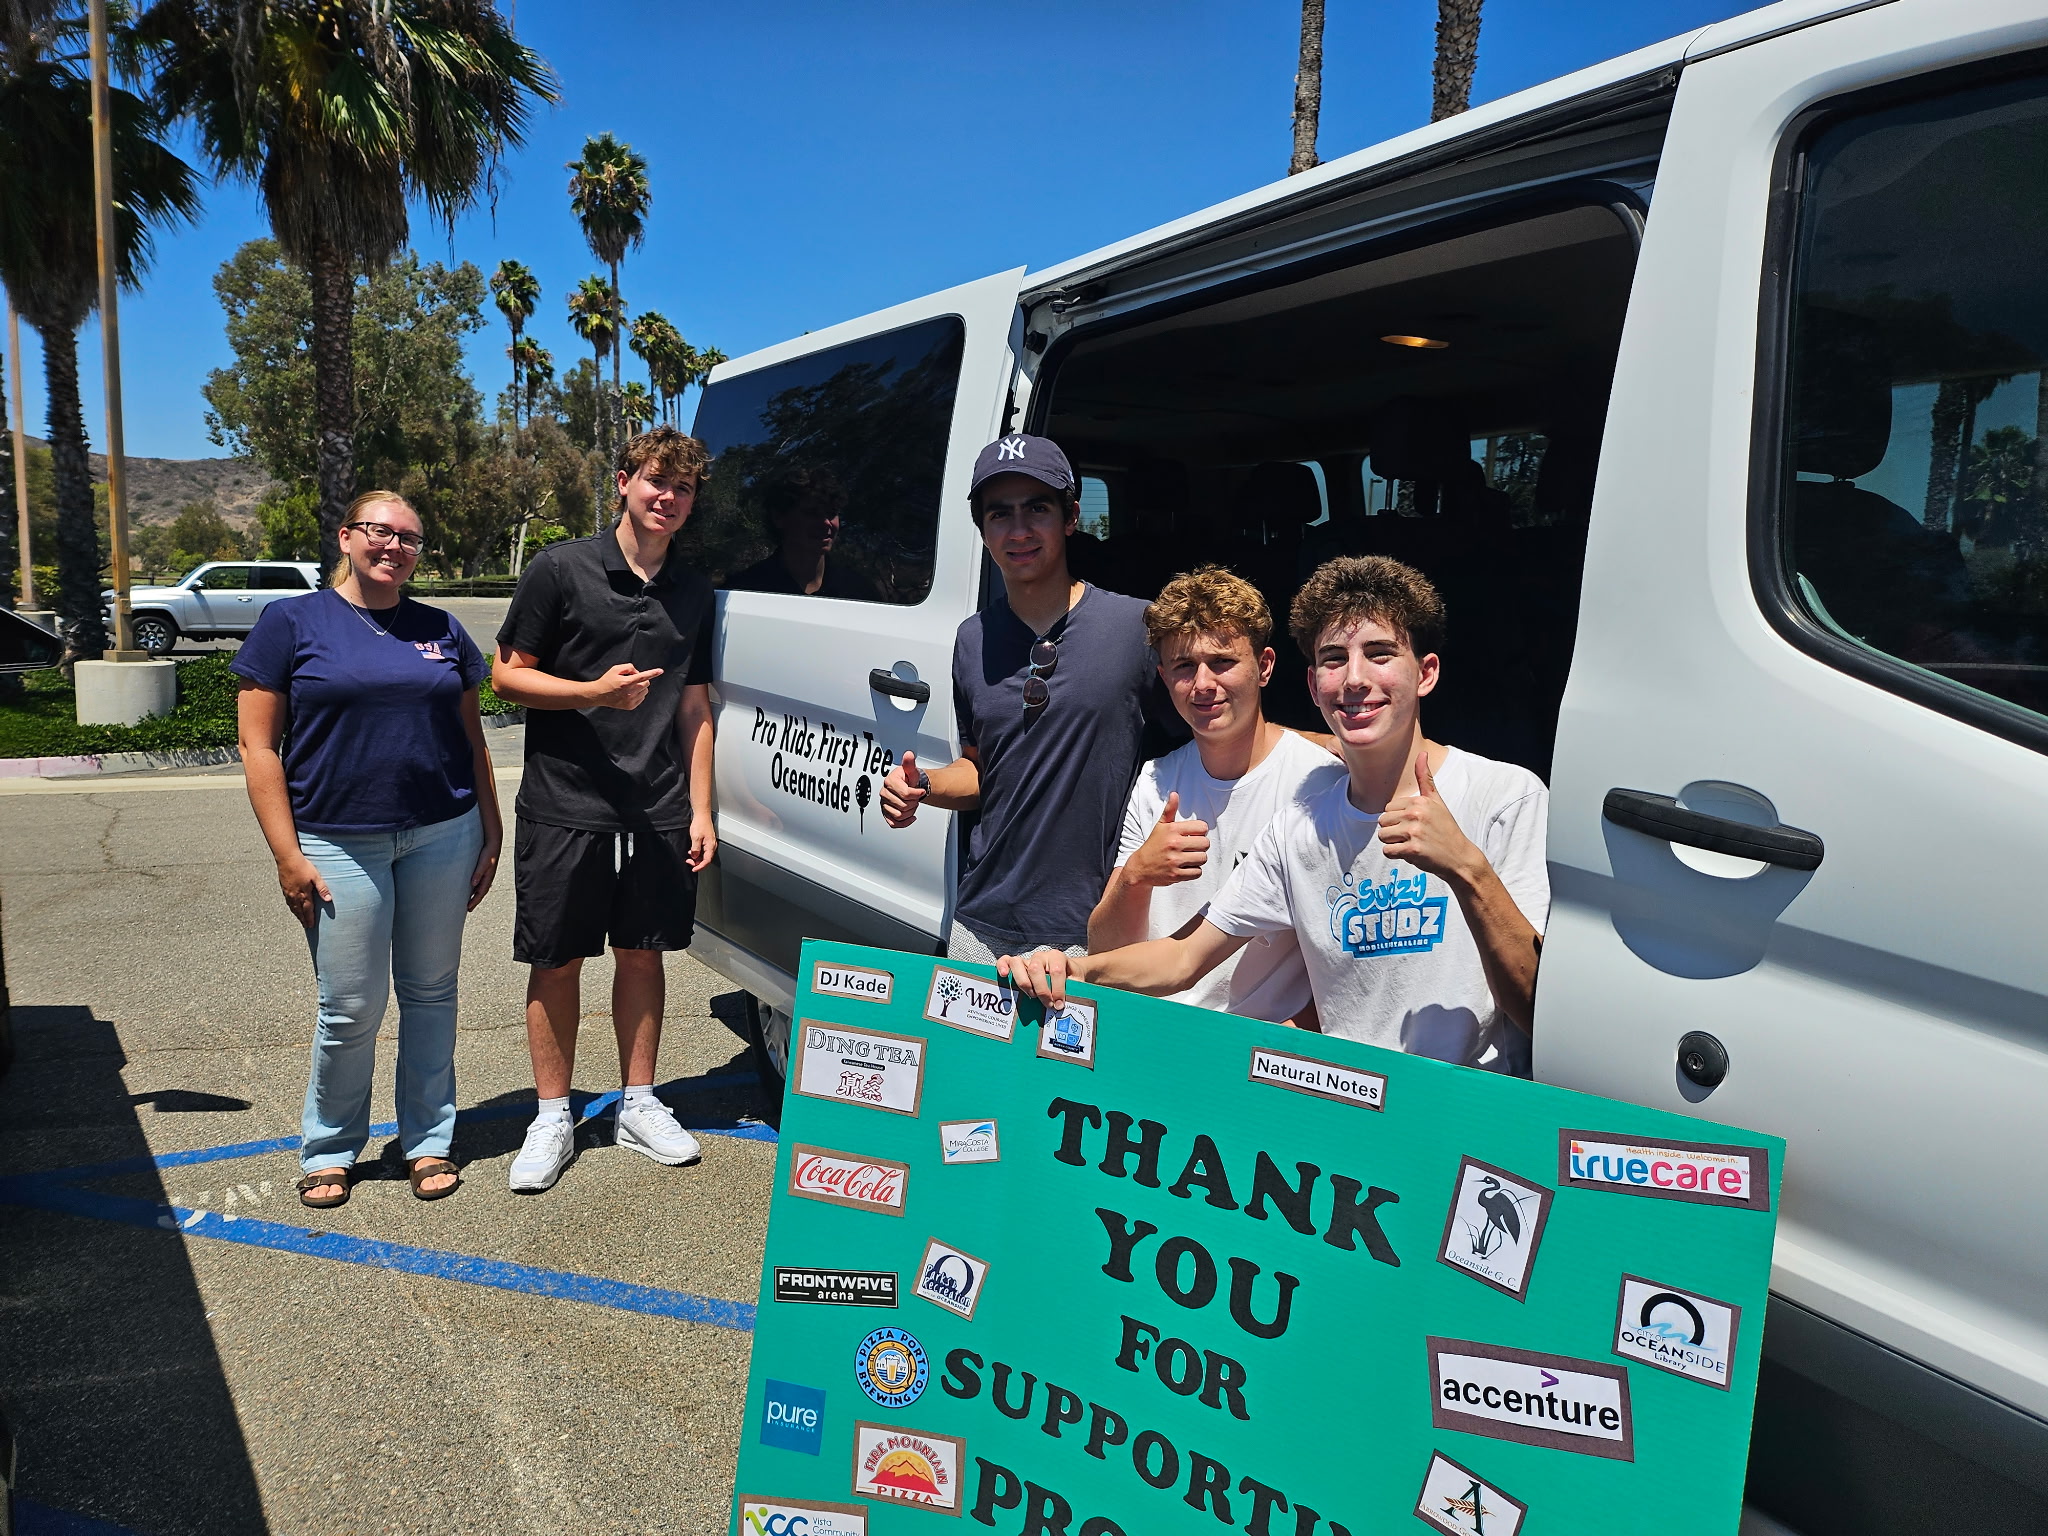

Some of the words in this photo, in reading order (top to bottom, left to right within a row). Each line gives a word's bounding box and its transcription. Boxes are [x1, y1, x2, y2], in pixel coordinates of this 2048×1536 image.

[414, 641, 442, 655] USA
[751, 706, 777, 747] Pro
[817, 721, 859, 769] First
[862, 730, 894, 778] Tee
[771, 752, 851, 814] Oceanside
[1347, 906, 1442, 944] STUDZ
[820, 970, 840, 987] DJ
[844, 974, 887, 994] Kade
[965, 987, 1013, 1016] WRC
[807, 1027, 871, 1058] DING
[873, 1043, 919, 1067] TEA
[1256, 1057, 1321, 1086] Natural
[1326, 1073, 1379, 1100] Notes
[1571, 1145, 1743, 1195] truecare
[1625, 1147, 1655, 1156] Health
[1656, 1148, 1684, 1159] inside.
[1686, 1153, 1726, 1164] Welcome
[1047, 1096, 1401, 1268] THANK
[779, 1272, 893, 1292] FRONTWAVE
[1094, 1206, 1301, 1339] YOU
[1448, 1249, 1493, 1277] Oceanside
[1494, 1271, 1504, 1282] G.
[1507, 1277, 1516, 1288] C.
[817, 1290, 854, 1301] arena
[922, 1276, 972, 1307] Recreation
[859, 1329, 895, 1358] PIZZA
[900, 1332, 926, 1365] PORT
[1621, 1331, 1726, 1374] OCEANSIDE
[1636, 1328, 1654, 1339] CITY
[1654, 1334, 1667, 1342] OF
[1114, 1314, 1251, 1421] FOR
[1654, 1352, 1687, 1371] Library
[858, 1371, 912, 1406] BREWING
[1442, 1377, 1620, 1431] accenture
[766, 1400, 818, 1427] pure
[771, 1419, 815, 1433] INSURANCE
[863, 1441, 889, 1473] FIRE
[886, 1435, 949, 1485] MOUNTAIN
[876, 1485, 934, 1504] PIZZA
[812, 1516, 832, 1527] Vista
